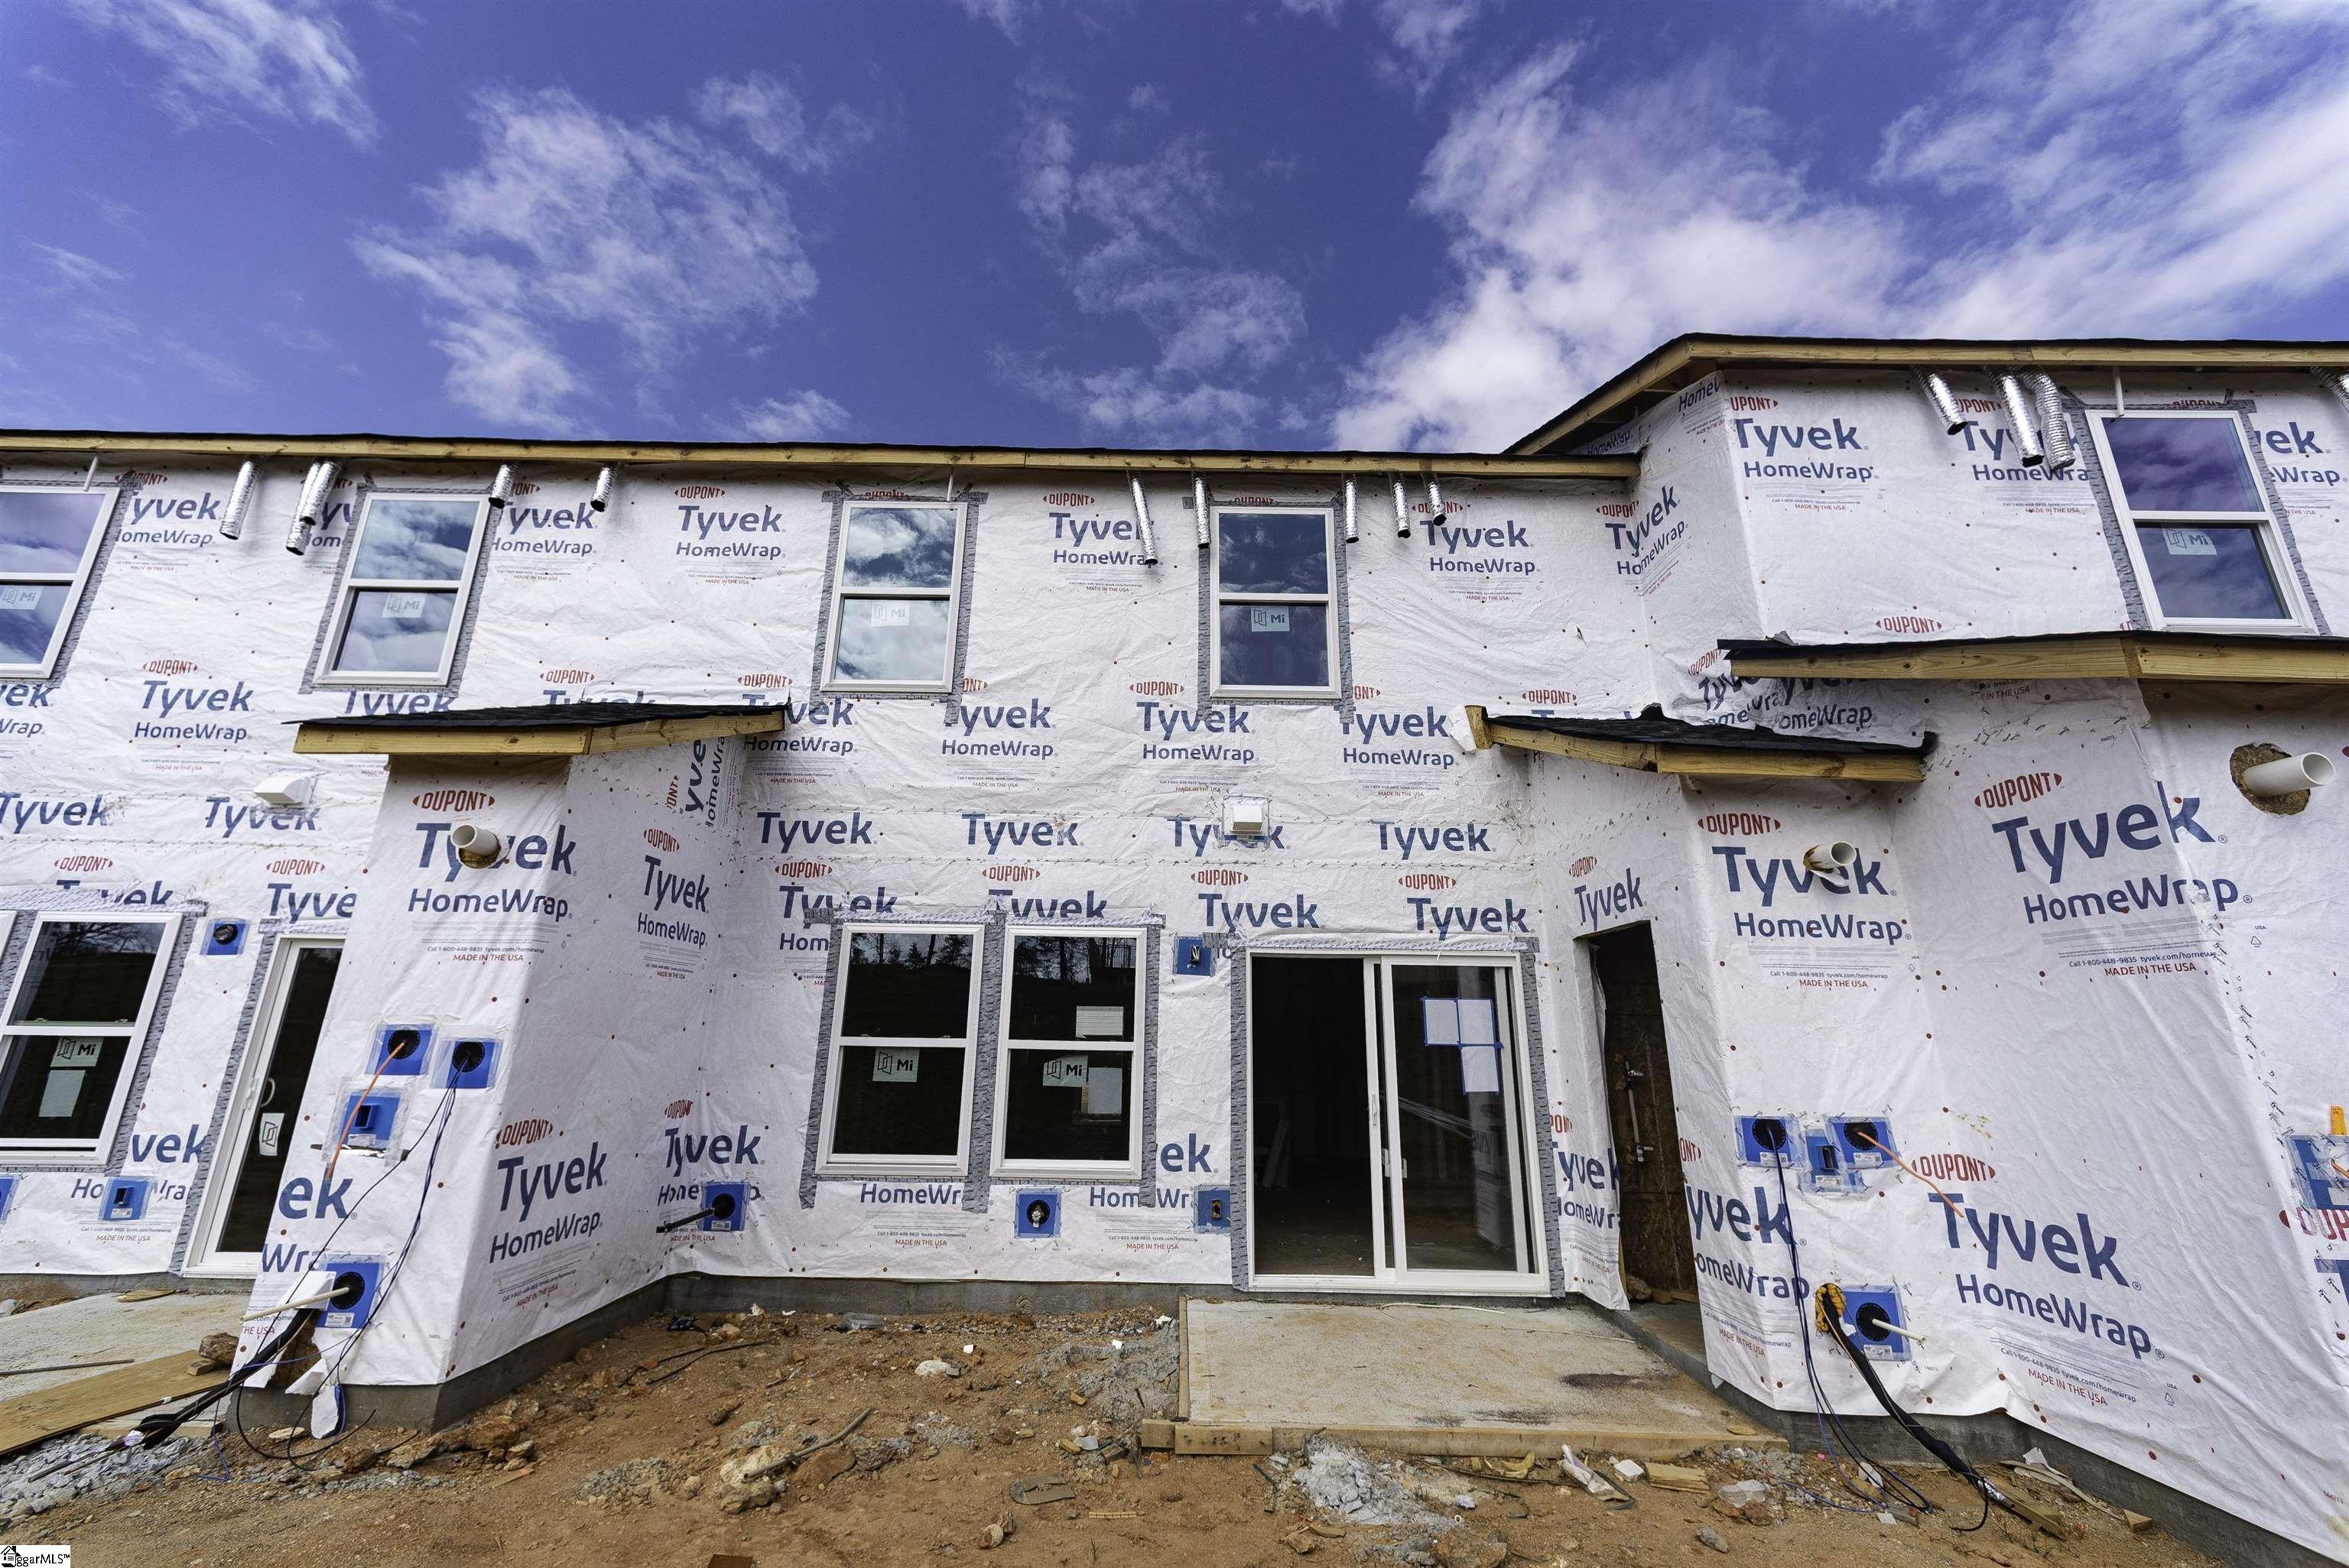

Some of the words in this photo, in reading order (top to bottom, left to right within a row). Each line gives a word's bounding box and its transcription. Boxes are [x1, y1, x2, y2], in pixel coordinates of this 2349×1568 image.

[1733, 418, 1861, 456] Tyvek
[1744, 461, 1873, 482] HomeWrap
[1973, 464, 2089, 481] HomeWra
[681, 486, 721, 499] DUPONT
[1049, 492, 1090, 506] DUPONT
[131, 492, 220, 524] yvek
[506, 502, 595, 534] yvek
[678, 505, 783, 539] Tyvek
[1605, 485, 1678, 557] Tyvek
[1419, 520, 1529, 554] Tyvek
[1617, 521, 1685, 575] HomeWrap
[2189, 534, 2209, 545] Mi
[677, 542, 782, 559] HomeWrap
[1054, 550, 1146, 566] HomeWra
[1430, 557, 1535, 576] HomeWrap
[1271, 614, 1285, 624] Mi
[1883, 617, 1935, 633] DUPONT
[149, 661, 193, 674] DUPONT
[546, 670, 590, 683] DUPONT
[744, 674, 788, 688] DUPONT
[1136, 682, 1178, 696] DUPONT
[1996, 690, 2012, 698] THE
[2013, 687, 2030, 695] USA
[141, 680, 254, 718] Tyvek
[1529, 690, 1571, 704] DUPONT
[940, 697, 1051, 736] yvek
[1136, 702, 1249, 741] Tyvek
[135, 722, 247, 742] HomeWrap
[745, 735, 853, 755] HomeWrap
[942, 740, 1053, 760] HomeWrap
[1142, 744, 1255, 765] HomeWrap
[1343, 748, 1454, 769] HomeWrap
[421, 790, 487, 812] DUPONT
[1983, 773, 2051, 809] DUPONT
[757, 812, 873, 852] Tyvek
[962, 813, 1078, 855] Tyvek
[1707, 813, 1772, 836] DUPONT
[1991, 781, 2216, 883] Tyvek
[647, 829, 677, 852] DUPONT
[1374, 822, 1490, 860] Tyvek
[61, 857, 108, 872] DUPONT
[273, 861, 320, 875] DUPONT
[781, 862, 827, 878] DUPONT
[989, 866, 1035, 881] DUPONT
[643, 855, 709, 913] Tyvek
[1198, 870, 1243, 885] DUPONT
[1405, 875, 1451, 890] DUPONT
[267, 884, 357, 924] Tyve
[408, 888, 568, 922] HomeWrap
[1574, 868, 1644, 930] Tyvek
[1198, 894, 1318, 935] Tyvek
[1407, 898, 1529, 940] Tyvek
[637, 913, 707, 950] HomeWrap
[1734, 913, 1902, 945] HomeWrap
[2082, 956, 2136, 966] 1-800-448-9835
[2104, 966, 2135, 977] MADE
[2150, 965, 2172, 973] THE
[2175, 963, 2196, 972] USA
[78, 1044, 96, 1056] Mi
[896, 1059, 913, 1071] Mi
[1066, 1063, 1082, 1076] Mi
[501, 1118, 550, 1145] DUPONT
[665, 1125, 761, 1177] Tyvek
[1920, 1154, 1987, 1181] DUPONT
[496, 1141, 608, 1222] Tyvek
[1686, 1186, 1797, 1245] yvek
[488, 1212, 601, 1264] HomeWrap
[1928, 1193, 2130, 1287] Tyvek
[1695, 1252, 1810, 1306] omeWrap
[1955, 1274, 2152, 1359] HomeWrap
[2028, 1368, 2055, 1385] MADE
[2056, 1378, 2065, 1388] IN
[2068, 1384, 2086, 1398] THE
[2087, 1391, 2107, 1405] USA
